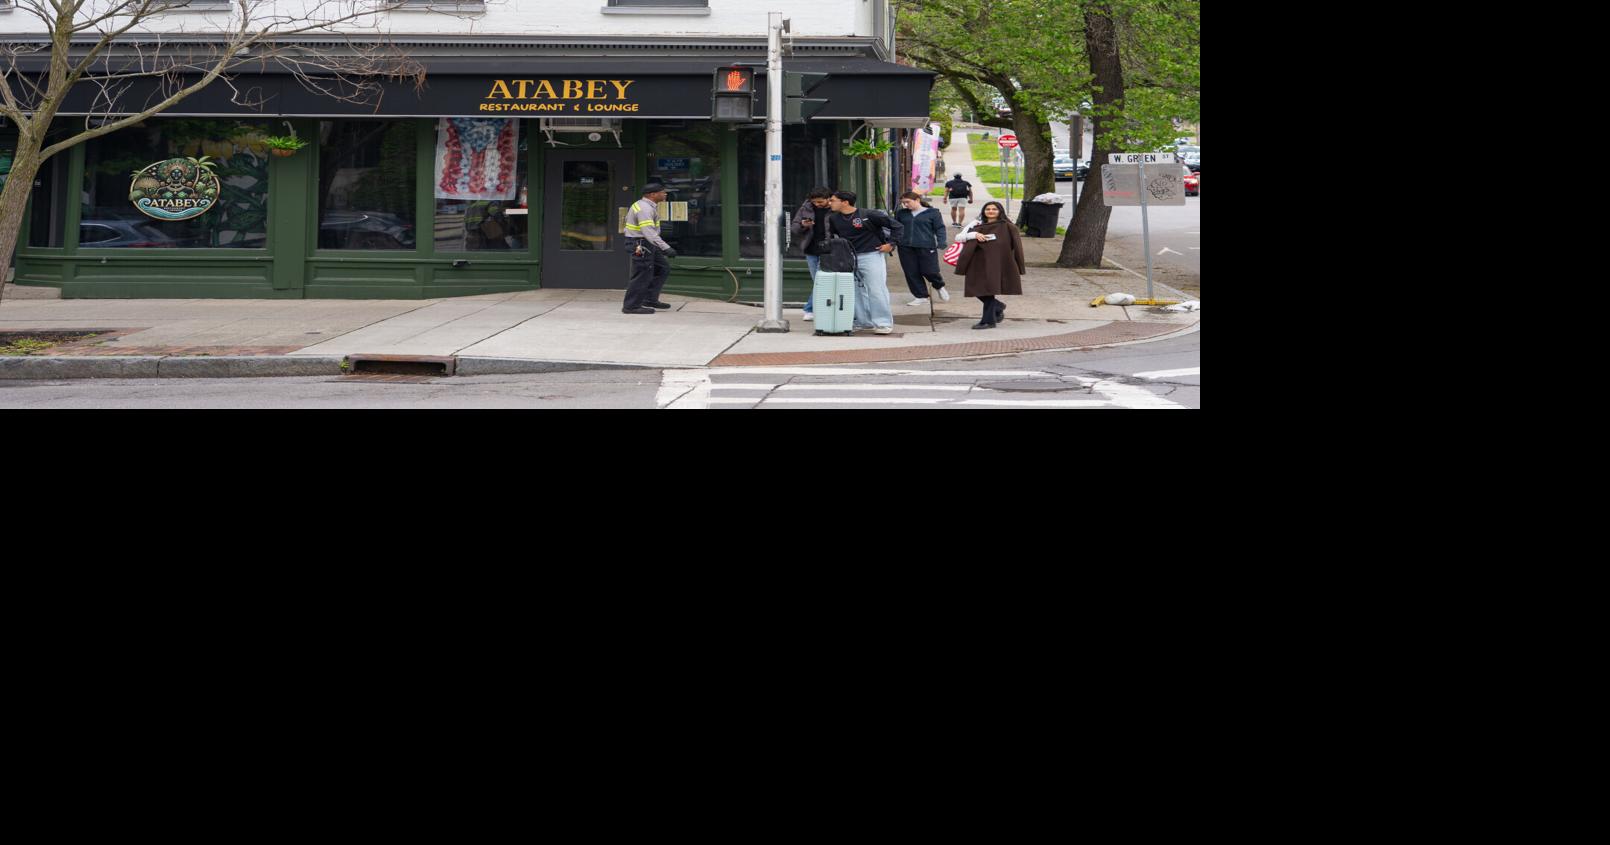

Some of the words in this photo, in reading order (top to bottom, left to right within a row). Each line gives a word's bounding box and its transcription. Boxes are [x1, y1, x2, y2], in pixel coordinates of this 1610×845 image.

[485, 79, 635, 100] ATABEY
[479, 103, 565, 112] RESTAURANT
[587, 103, 639, 112] LOUNGE
[1113, 154, 1125, 163] W.
[1127, 154, 1156, 163] GREN
[150, 199, 200, 207] ATABEY
